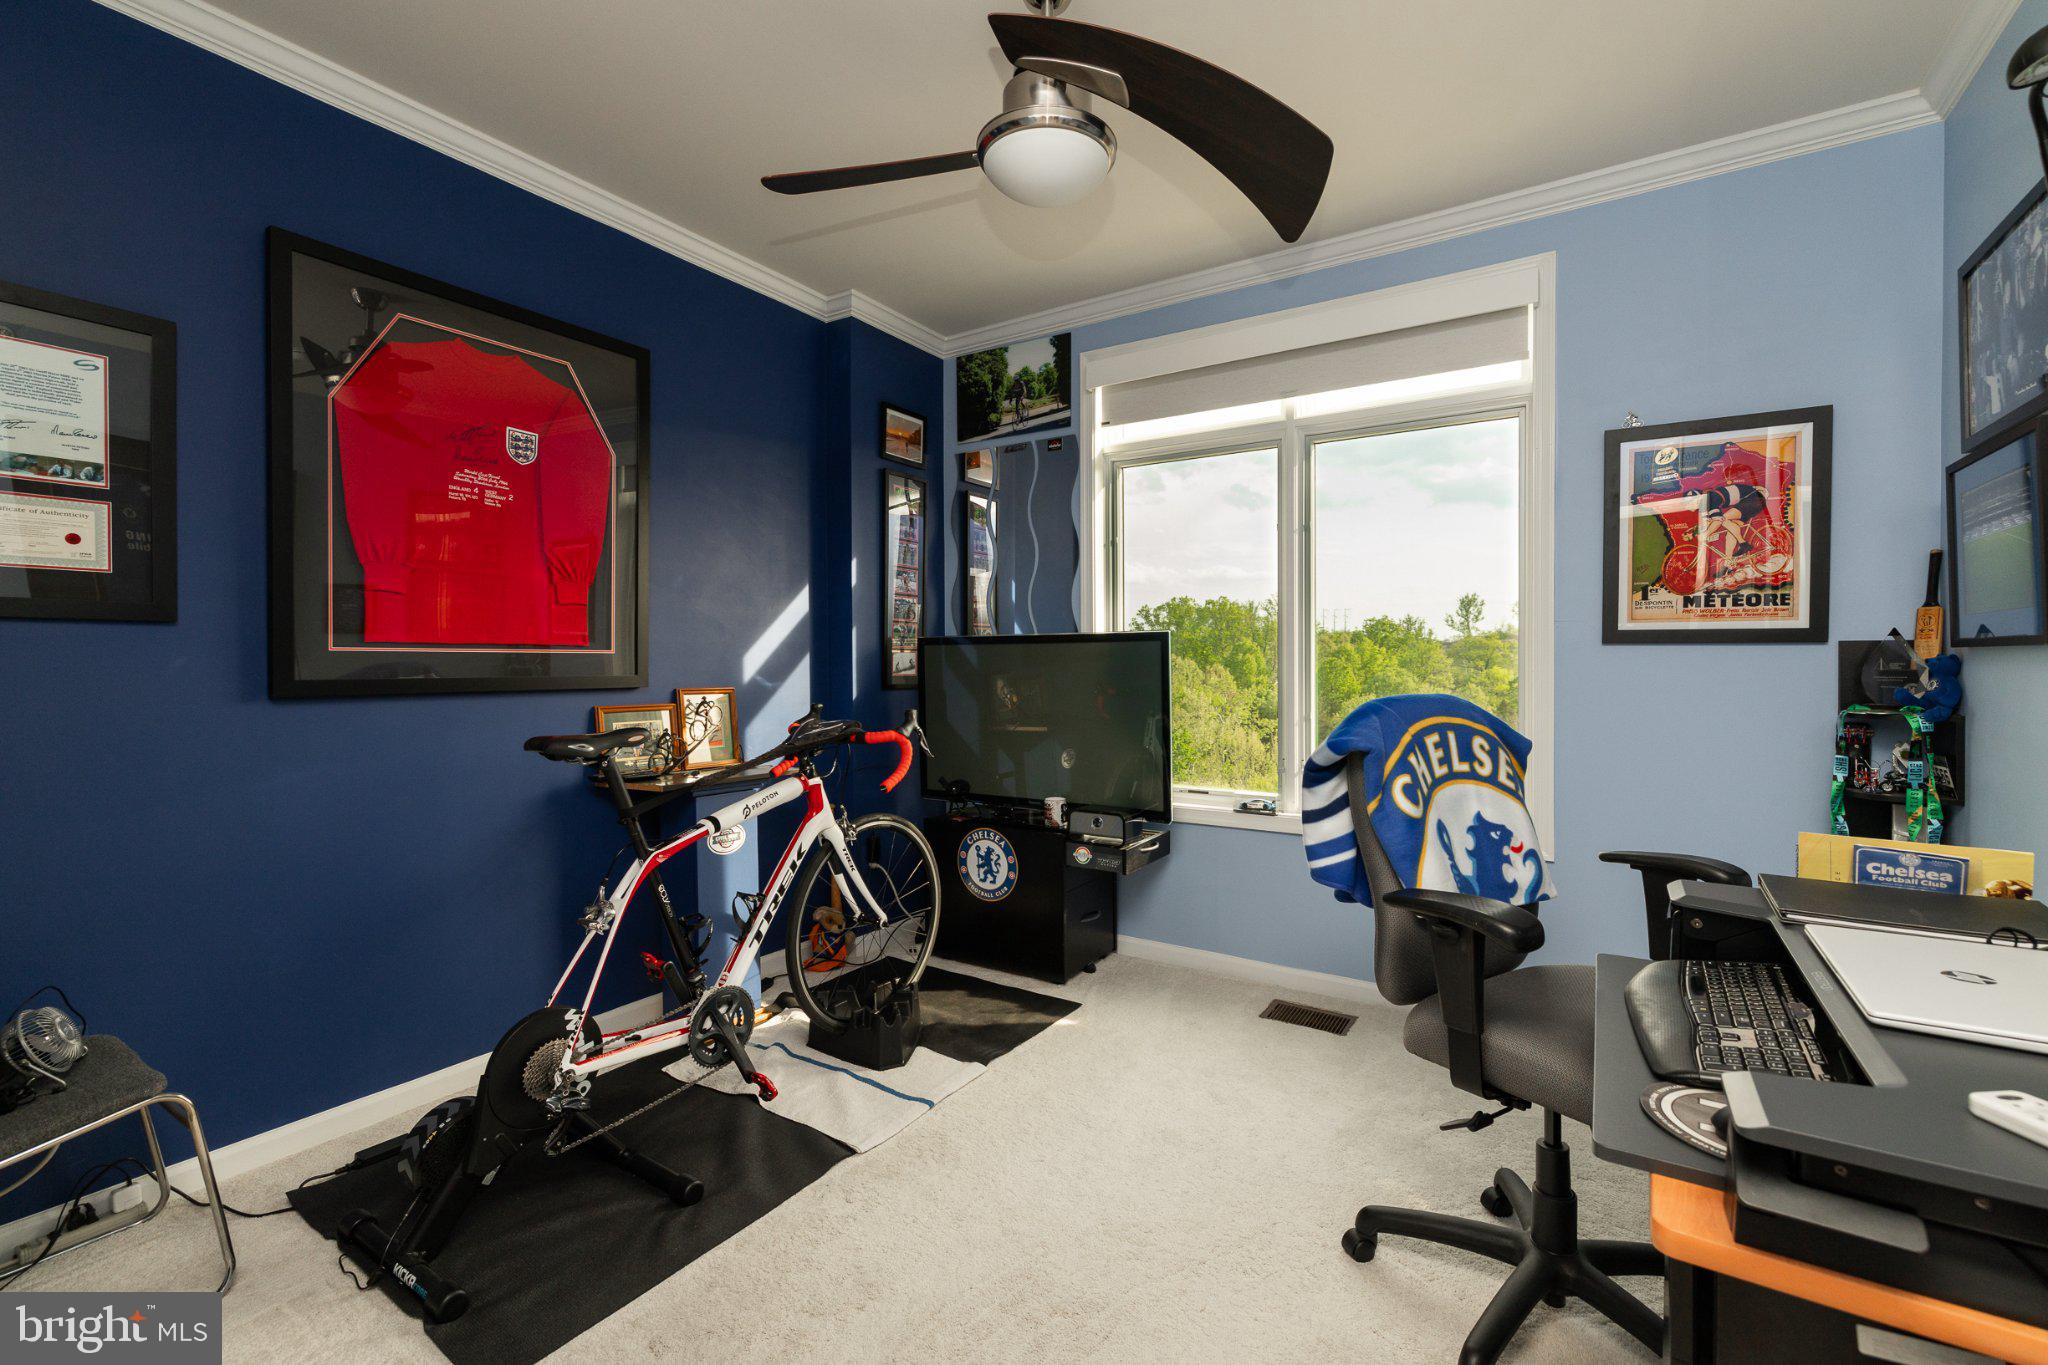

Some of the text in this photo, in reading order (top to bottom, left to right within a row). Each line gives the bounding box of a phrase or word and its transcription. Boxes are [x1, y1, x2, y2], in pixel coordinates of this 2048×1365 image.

[39, 509, 90, 520] Authenticity
[1391, 730, 1524, 819] CHELSE
[752, 791, 779, 810] PELOTON
[967, 830, 1006, 848] CHELSEA
[1866, 862, 1953, 883] Chelsea
[1871, 874, 1919, 885] Football
[1920, 879, 1948, 889] Club
[749, 842, 806, 948] TREK
[968, 881, 1008, 898] FOOTBALL CLUB
[393, 1262, 417, 1290] KICKR
